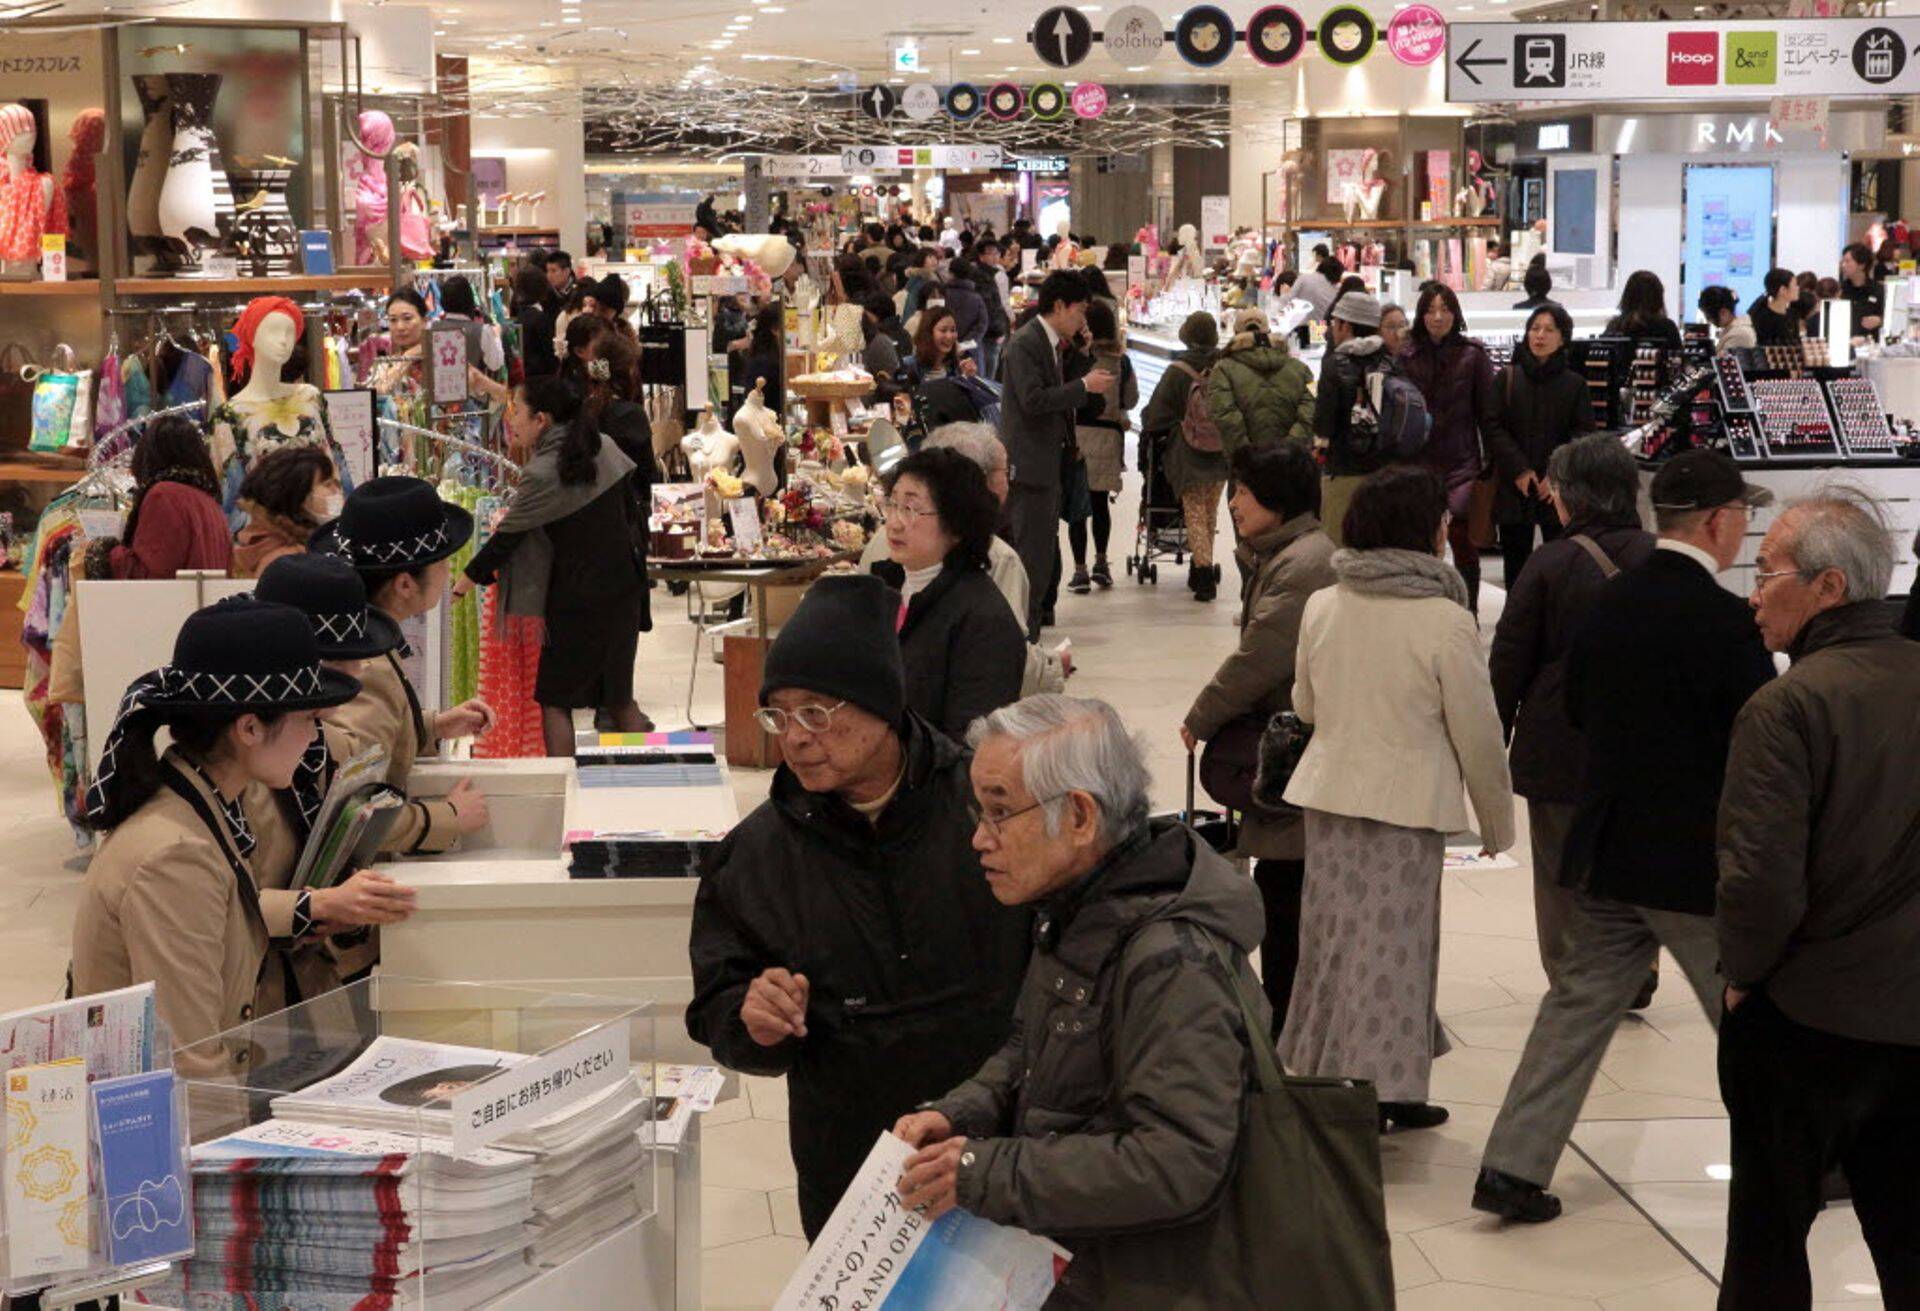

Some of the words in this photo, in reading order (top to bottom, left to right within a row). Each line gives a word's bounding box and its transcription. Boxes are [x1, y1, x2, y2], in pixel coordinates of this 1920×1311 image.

[1105, 33, 1164, 49] solaha
[1569, 51, 1606, 69] JR線
[1671, 51, 1715, 66] Hoop
[1784, 48, 1850, 65] エレベーター
[1697, 122, 1784, 143] RMK
[1017, 160, 1066, 171] KIEHL'S
[471, 1049, 615, 1129] ご自由にお持ち帰りください
[889, 1199, 934, 1254] OPEN
[818, 1174, 903, 1311] あべのハルカ
